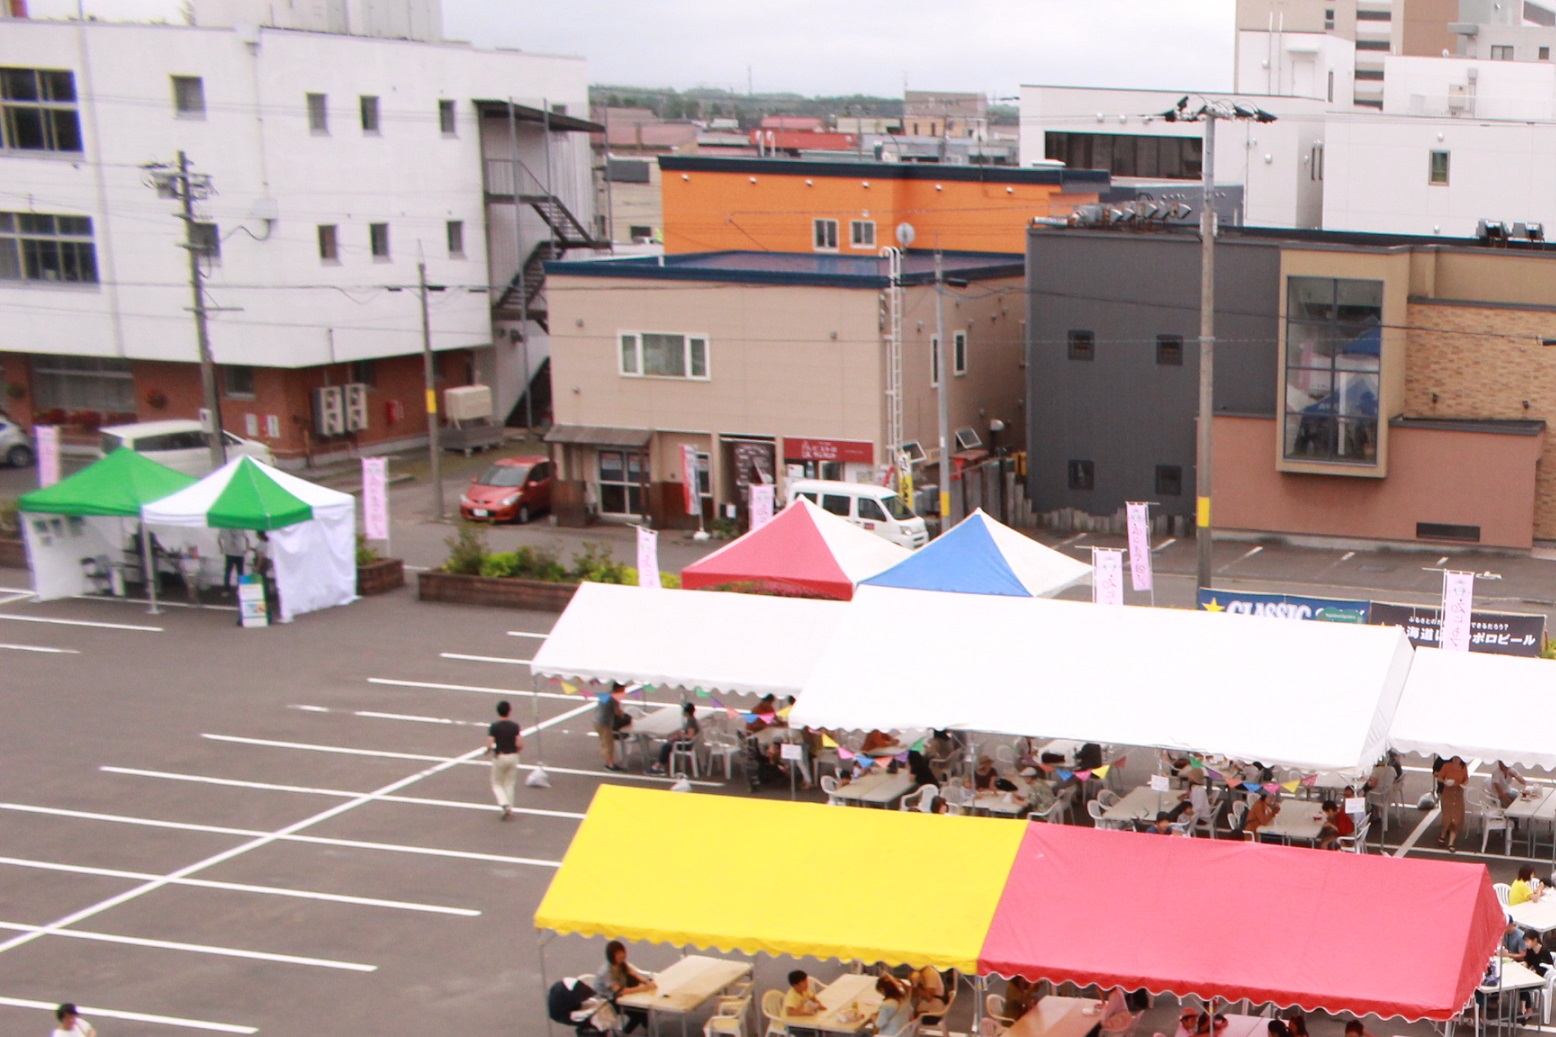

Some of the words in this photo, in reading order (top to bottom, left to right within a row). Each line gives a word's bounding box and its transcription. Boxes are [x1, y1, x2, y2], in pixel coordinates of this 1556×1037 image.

[1469, 631, 1536, 646] ポロビール
